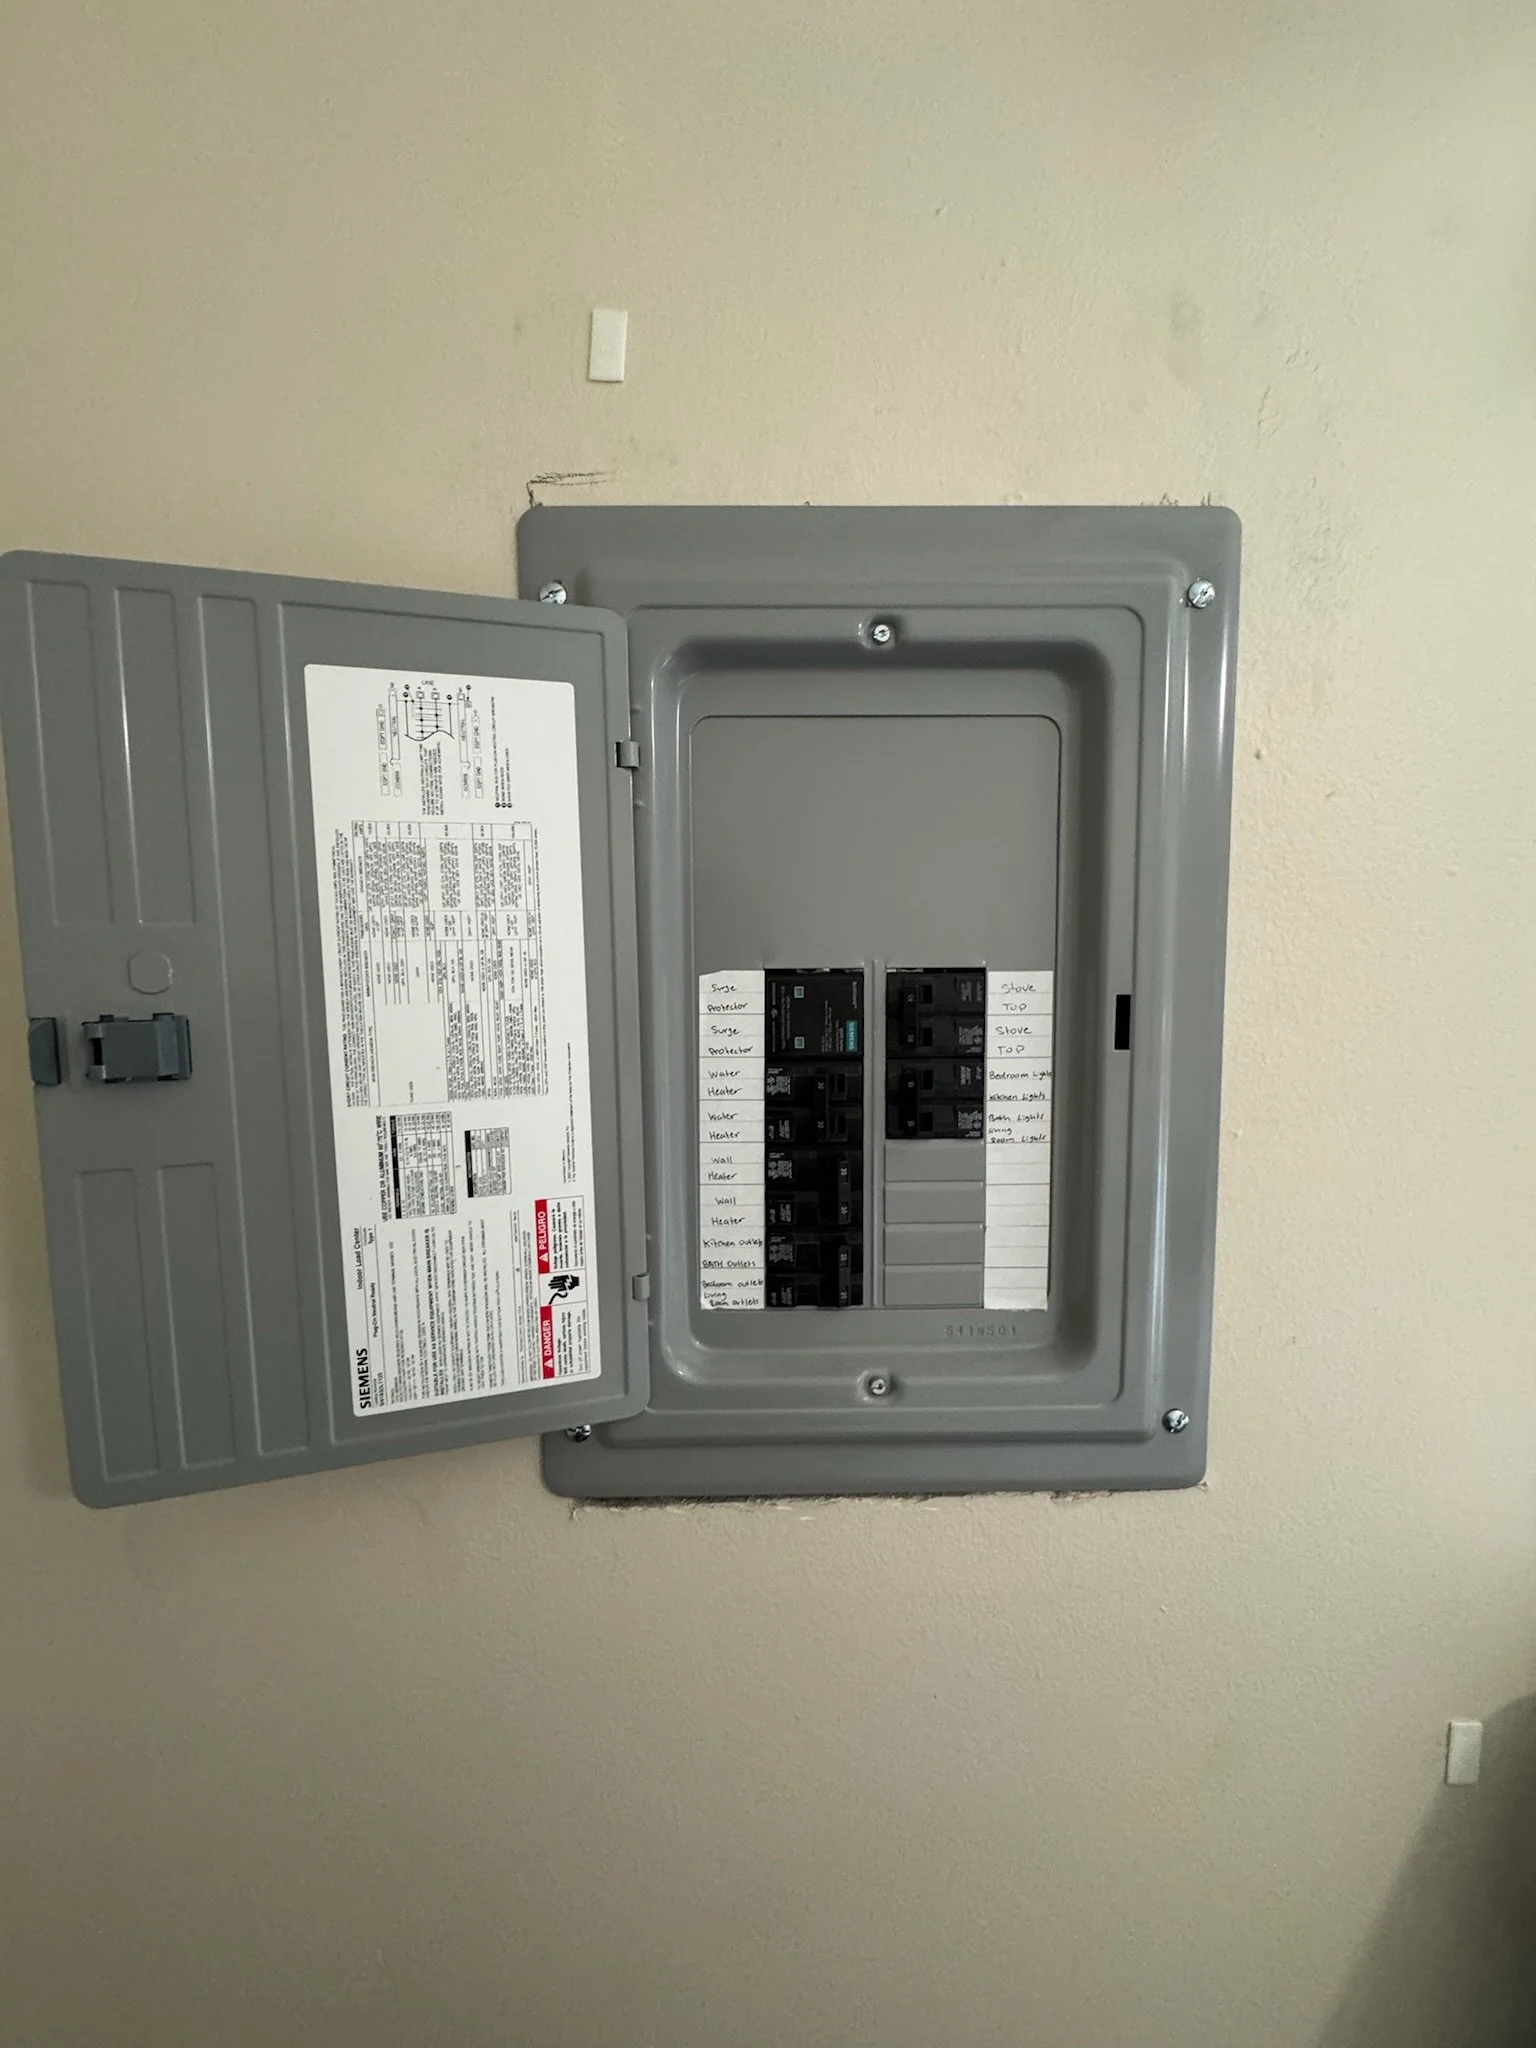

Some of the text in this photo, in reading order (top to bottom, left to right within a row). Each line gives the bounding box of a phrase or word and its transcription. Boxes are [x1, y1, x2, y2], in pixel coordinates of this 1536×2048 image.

[711, 983, 737, 993] Surge
[1001, 982, 1037, 994] Stove
[707, 1002, 748, 1012] Protector
[711, 1026, 740, 1037] Surge
[995, 1025, 1032, 1035] Stove
[708, 1046, 753, 1055] Protector
[708, 1069, 740, 1079] Water
[989, 1070, 1029, 1080] Bedroom
[707, 1086, 742, 1096] Heater
[1021, 1091, 1046, 1102] Lights
[708, 1112, 739, 1121] Water
[1017, 1111, 1045, 1123] Lights
[709, 1130, 740, 1141] Heater
[708, 1171, 737, 1181] Heater
[715, 1197, 736, 1205] Wall
[711, 1217, 745, 1226] Heater
[538, 1211, 547, 1250] PELIGRO
[354, 1251, 362, 1267] Load
[542, 1320, 551, 1356] DANGER
[356, 1348, 371, 1408] SIEMENS
